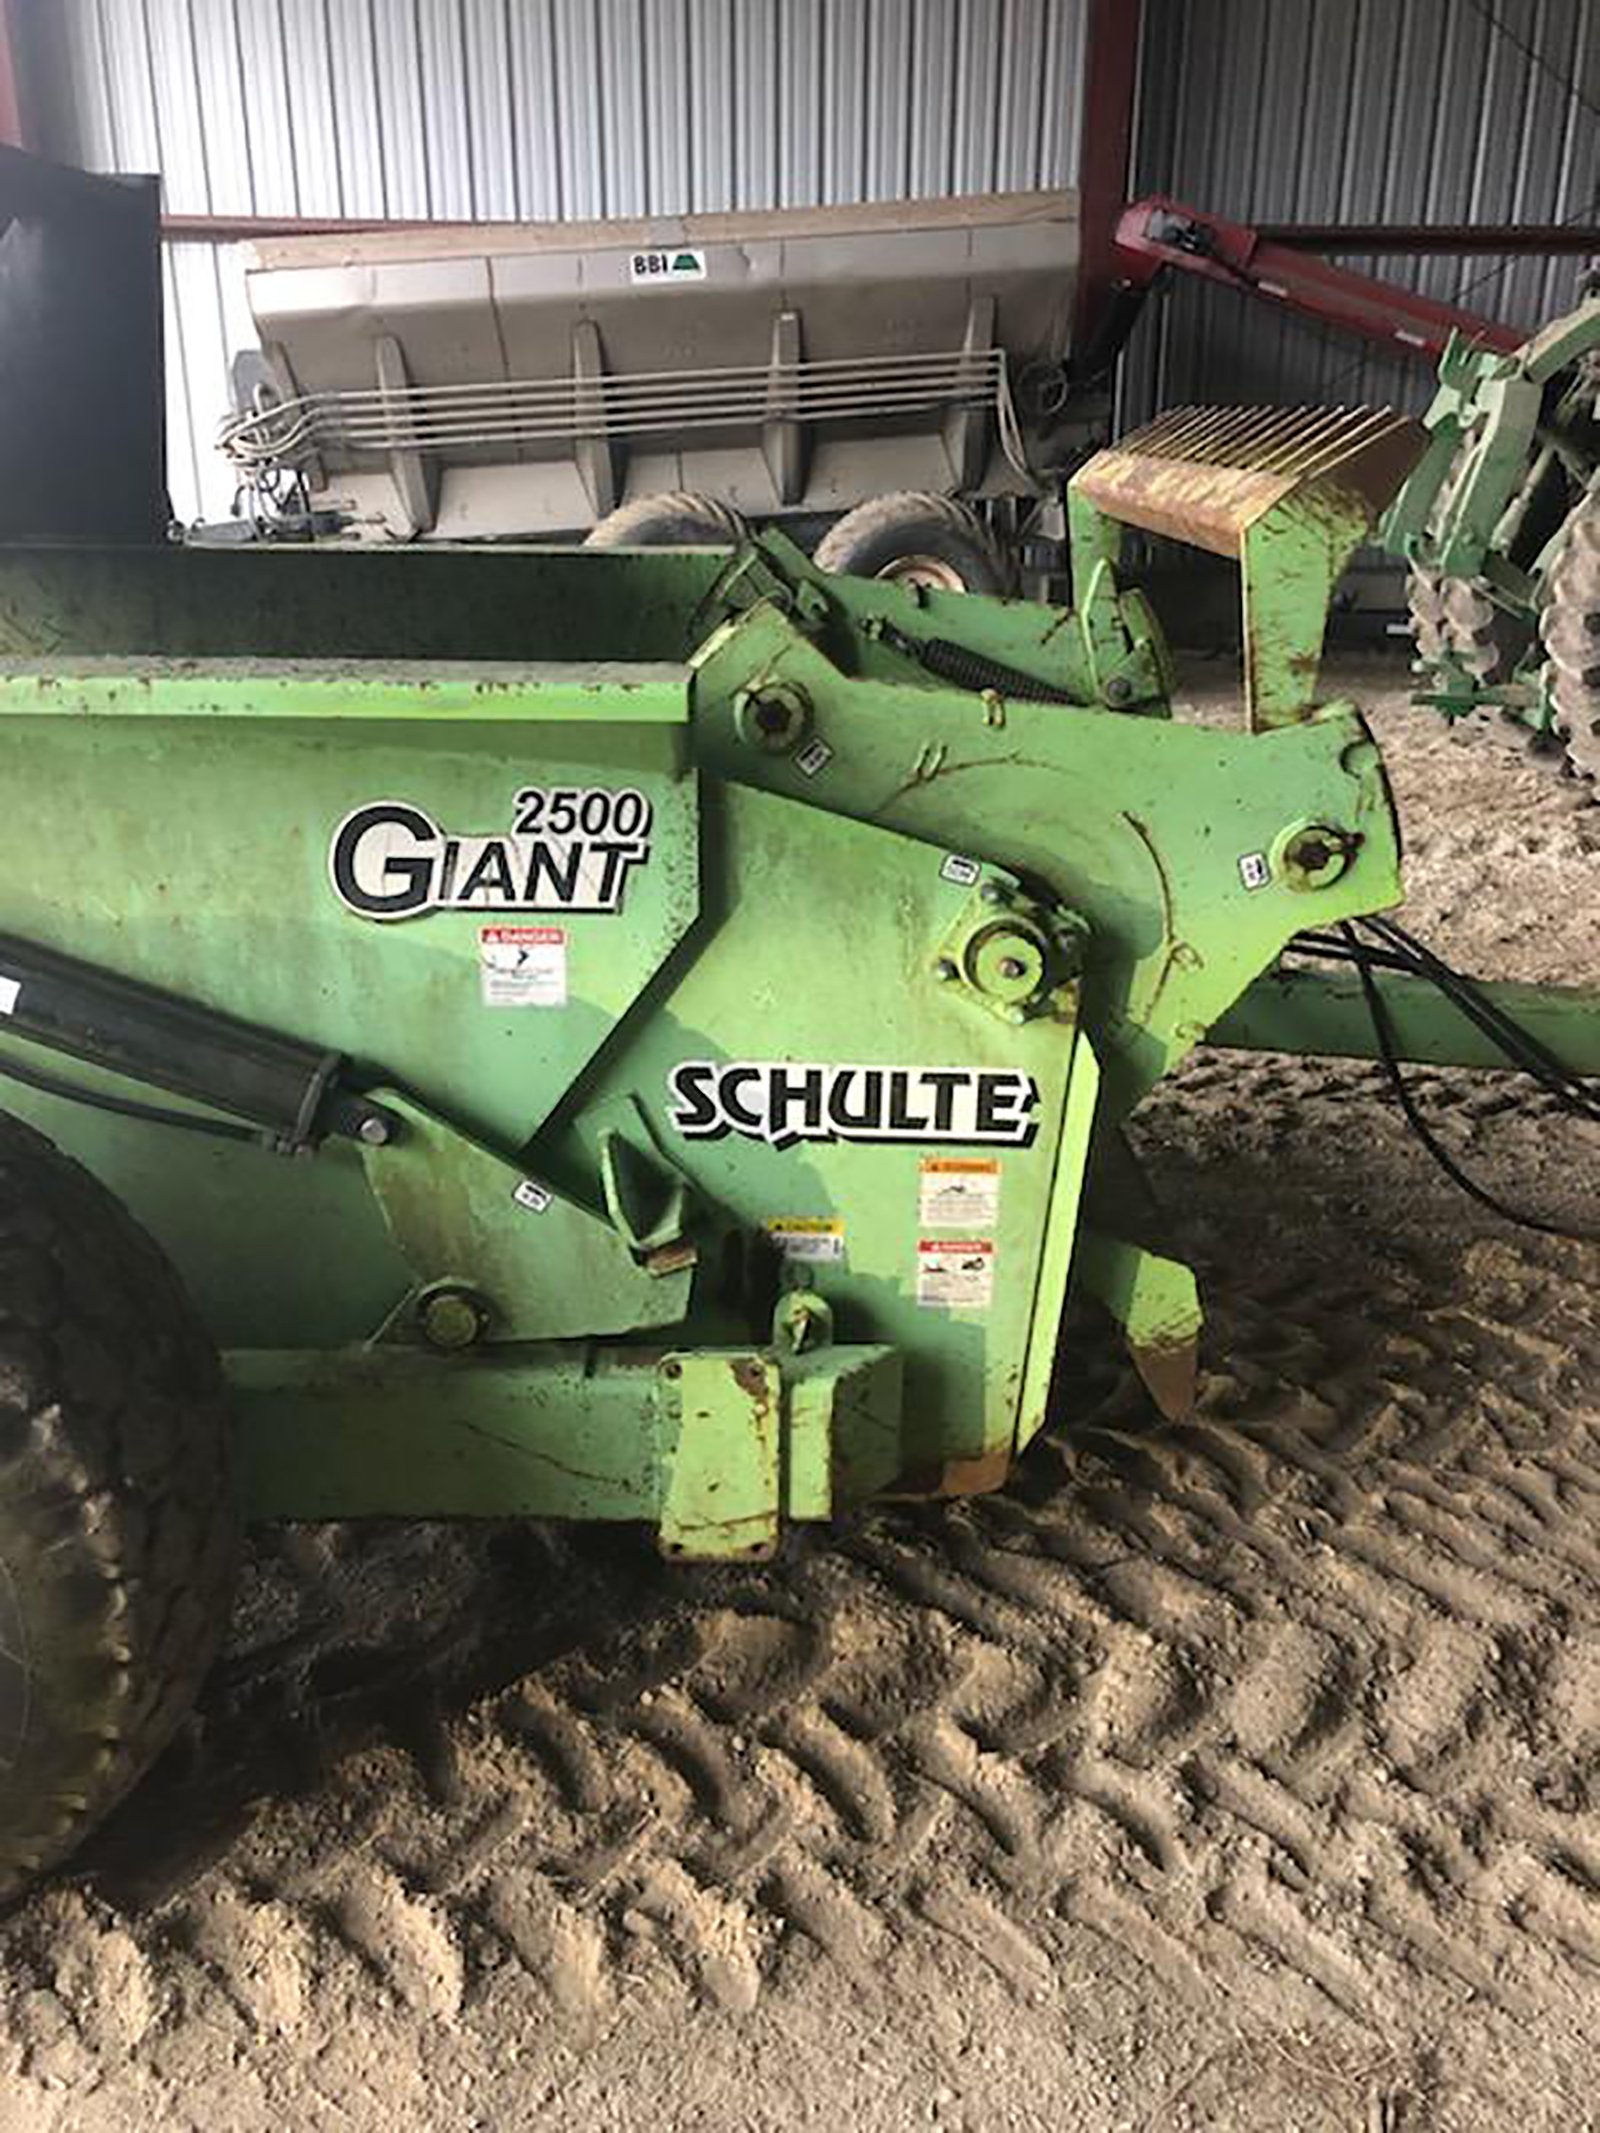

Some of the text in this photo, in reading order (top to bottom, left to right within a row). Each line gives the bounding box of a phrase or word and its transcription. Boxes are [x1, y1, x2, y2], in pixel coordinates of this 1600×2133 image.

[634, 254, 668, 274] BBI
[516, 790, 643, 837] 2500
[334, 805, 639, 914] GIANT
[675, 1067, 1022, 1132] SCHULTE
